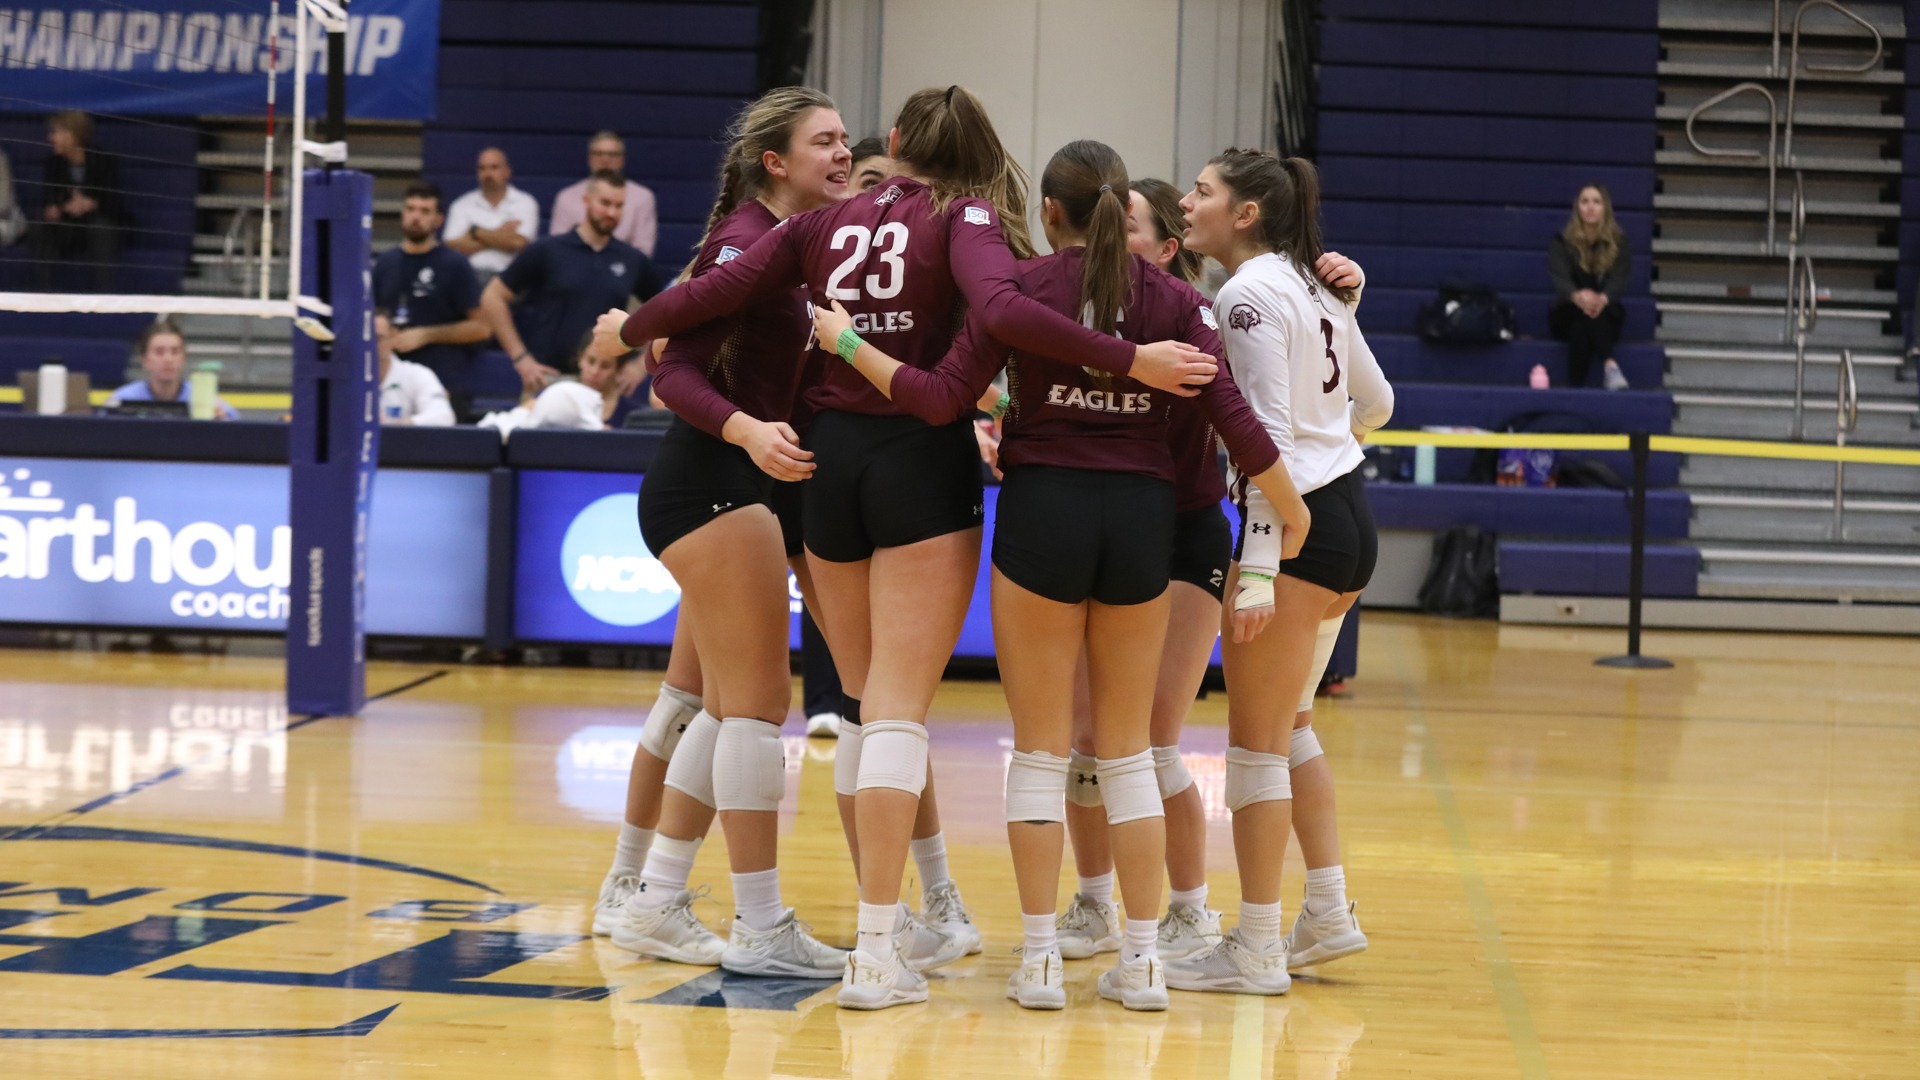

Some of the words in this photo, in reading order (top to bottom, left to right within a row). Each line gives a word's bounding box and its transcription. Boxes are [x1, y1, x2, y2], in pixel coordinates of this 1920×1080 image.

[825, 221, 909, 300] 23
[851, 310, 915, 334] GLES
[1320, 318, 1341, 394] 3
[1046, 384, 1151, 414] EAGLES
